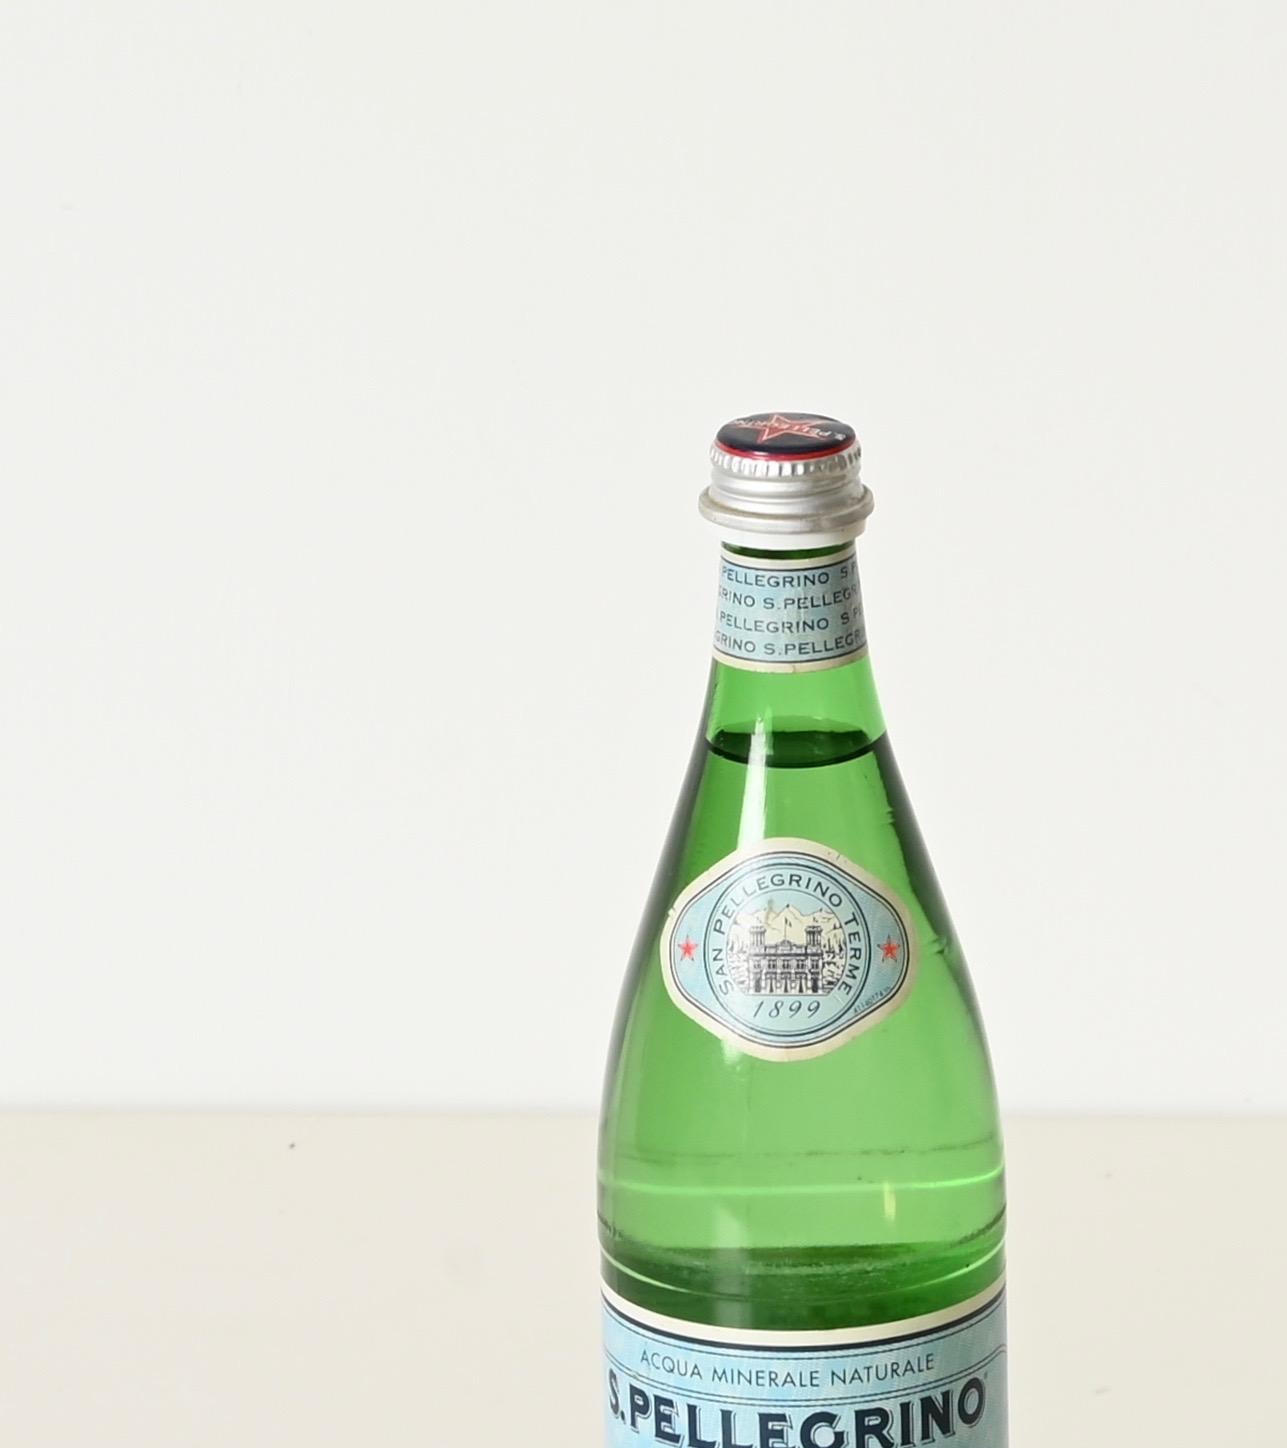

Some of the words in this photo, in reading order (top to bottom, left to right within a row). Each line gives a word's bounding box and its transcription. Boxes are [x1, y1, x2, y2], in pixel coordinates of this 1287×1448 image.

[722, 565, 829, 588] PELLEGRINO
[720, 610, 829, 633] PELLEGRINO
[713, 873, 843, 936] PELLEGRINO
[713, 947, 735, 996] SAN
[837, 912, 862, 996] TERME
[752, 999, 821, 1018] 1899
[640, 1349, 703, 1380] ACQUA
[711, 1366, 820, 1388] MINERALE
[830, 1353, 935, 1387] NATURALE
